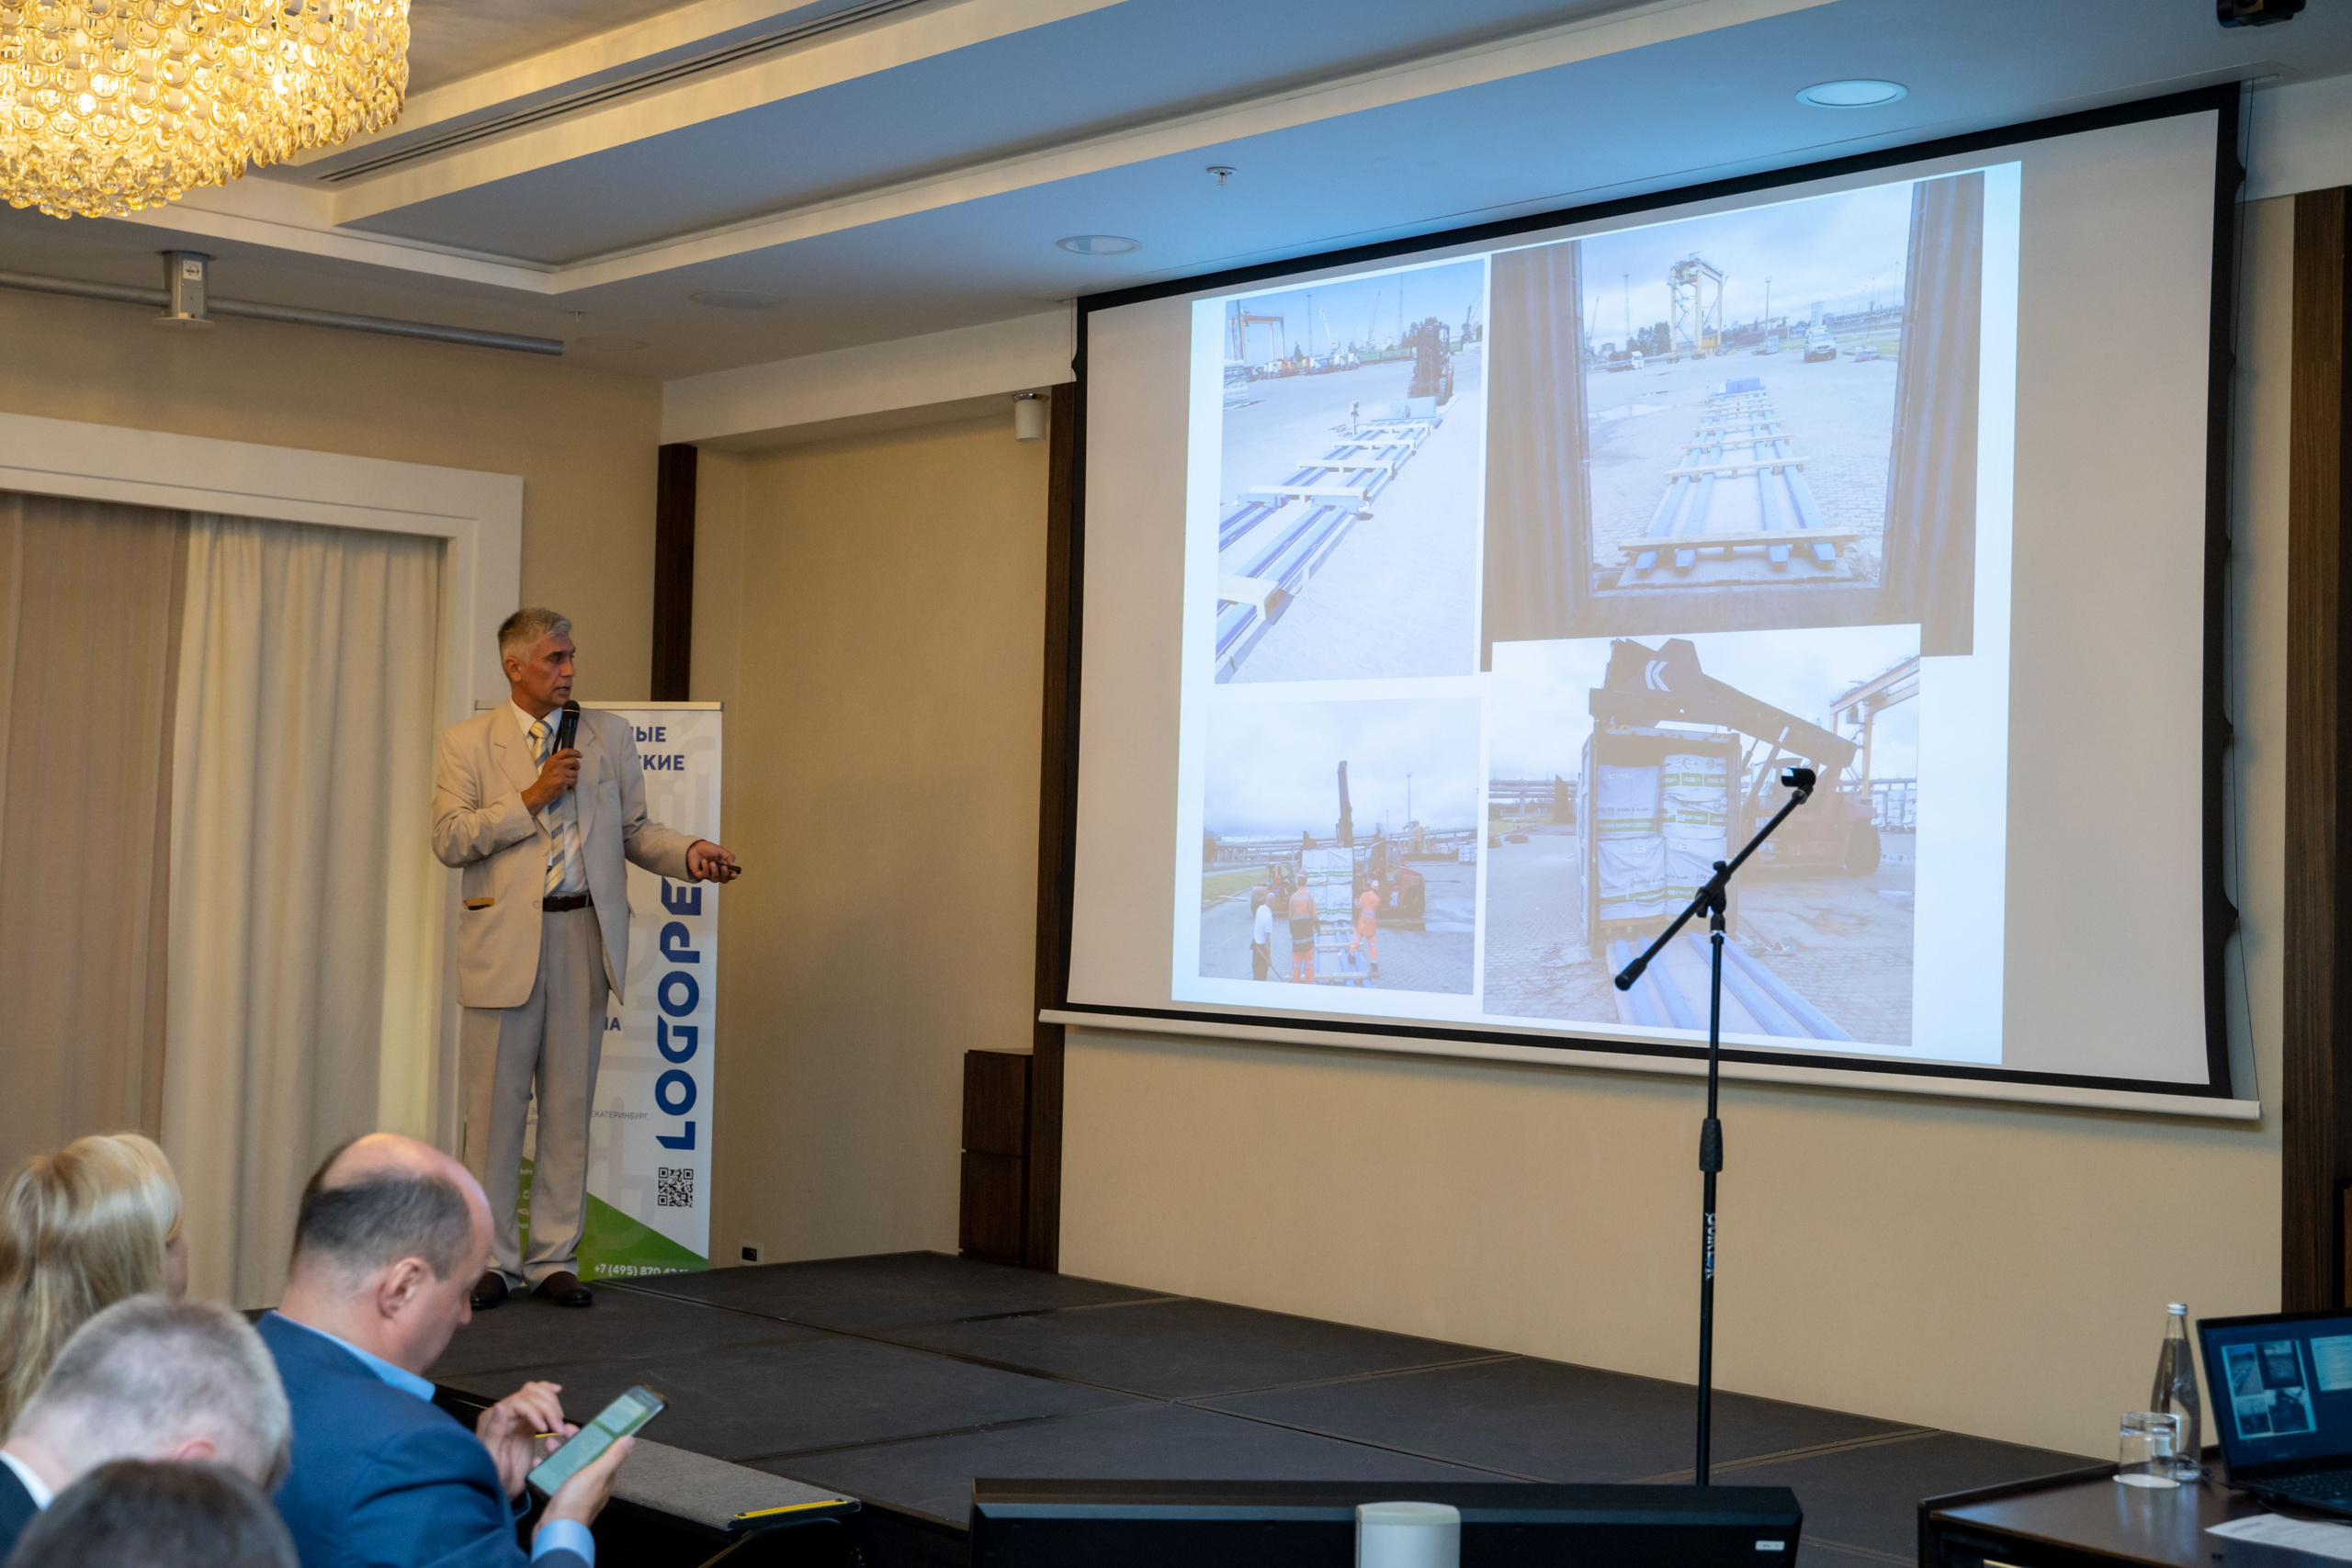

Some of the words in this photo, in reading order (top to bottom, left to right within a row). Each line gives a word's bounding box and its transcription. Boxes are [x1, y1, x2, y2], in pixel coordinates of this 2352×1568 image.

[631, 726, 667, 742] ЫЕ
[639, 754, 685, 771] КИЕ
[594, 1263, 606, 1274] +7
[608, 1264, 638, 1277] (495)
